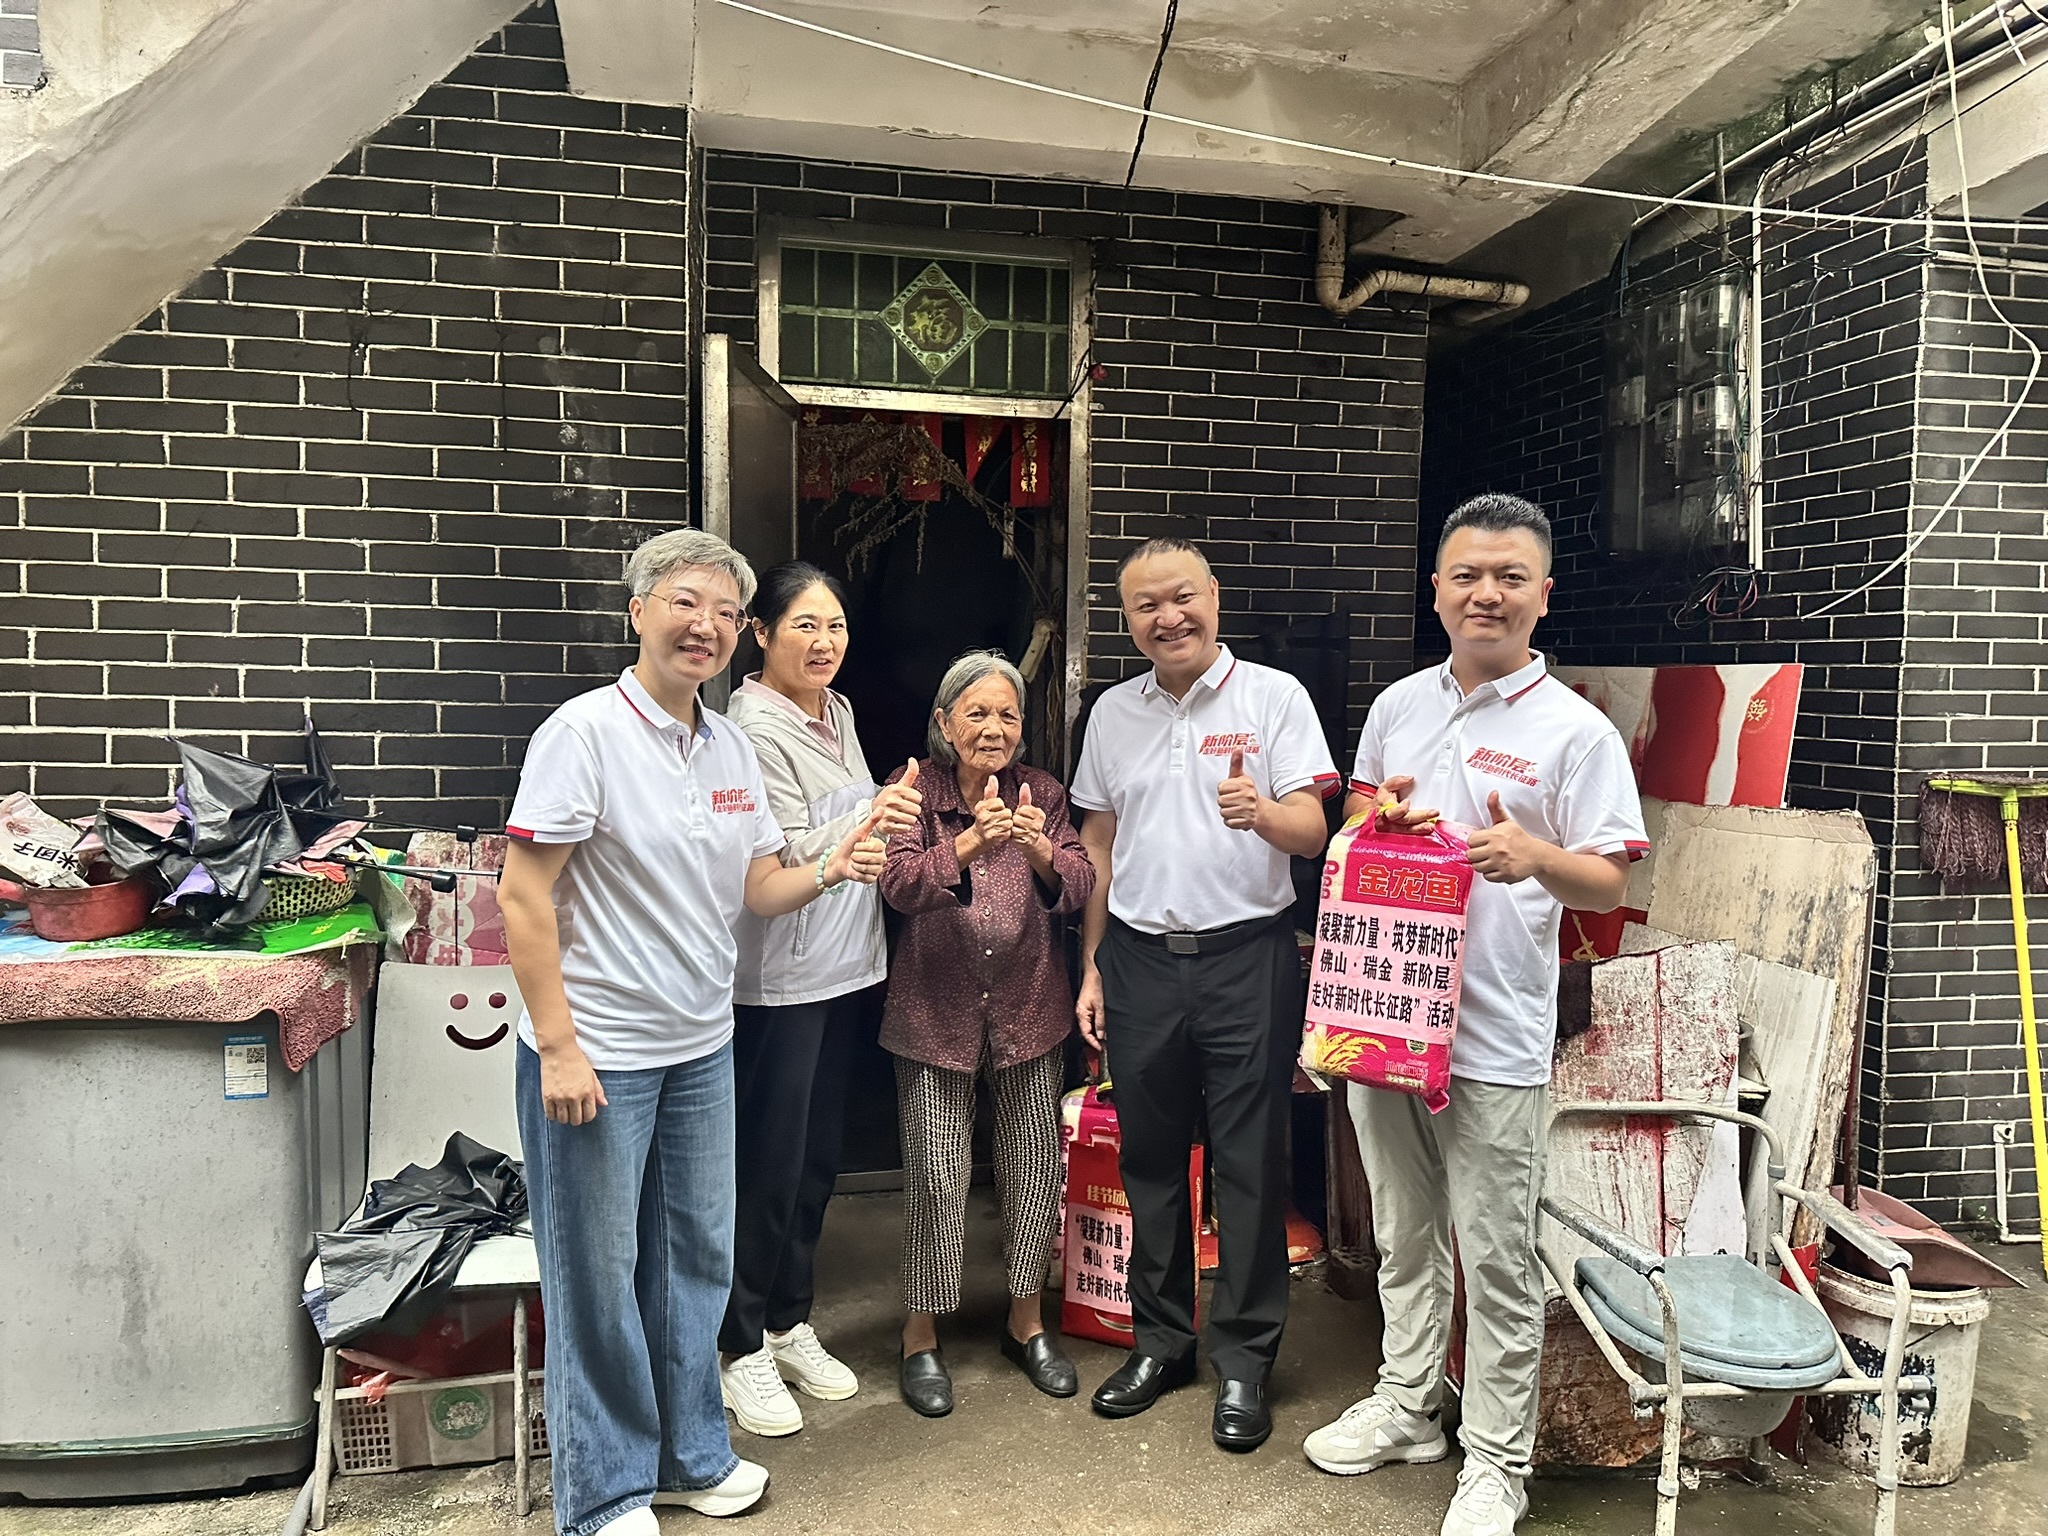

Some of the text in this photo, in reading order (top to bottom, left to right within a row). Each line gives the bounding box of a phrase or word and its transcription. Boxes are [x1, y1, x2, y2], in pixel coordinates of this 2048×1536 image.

[1200, 732, 1250, 749] 新阶层
[1466, 747, 1532, 774] 新阶层
[1469, 760, 1540, 787] 走好新时代长征路
[1357, 864, 1459, 907] 金龙鱼
[1402, 960, 1450, 991] 新阶层
[1427, 1000, 1455, 1029] 活动
[1087, 1184, 1130, 1207] 佳节团
